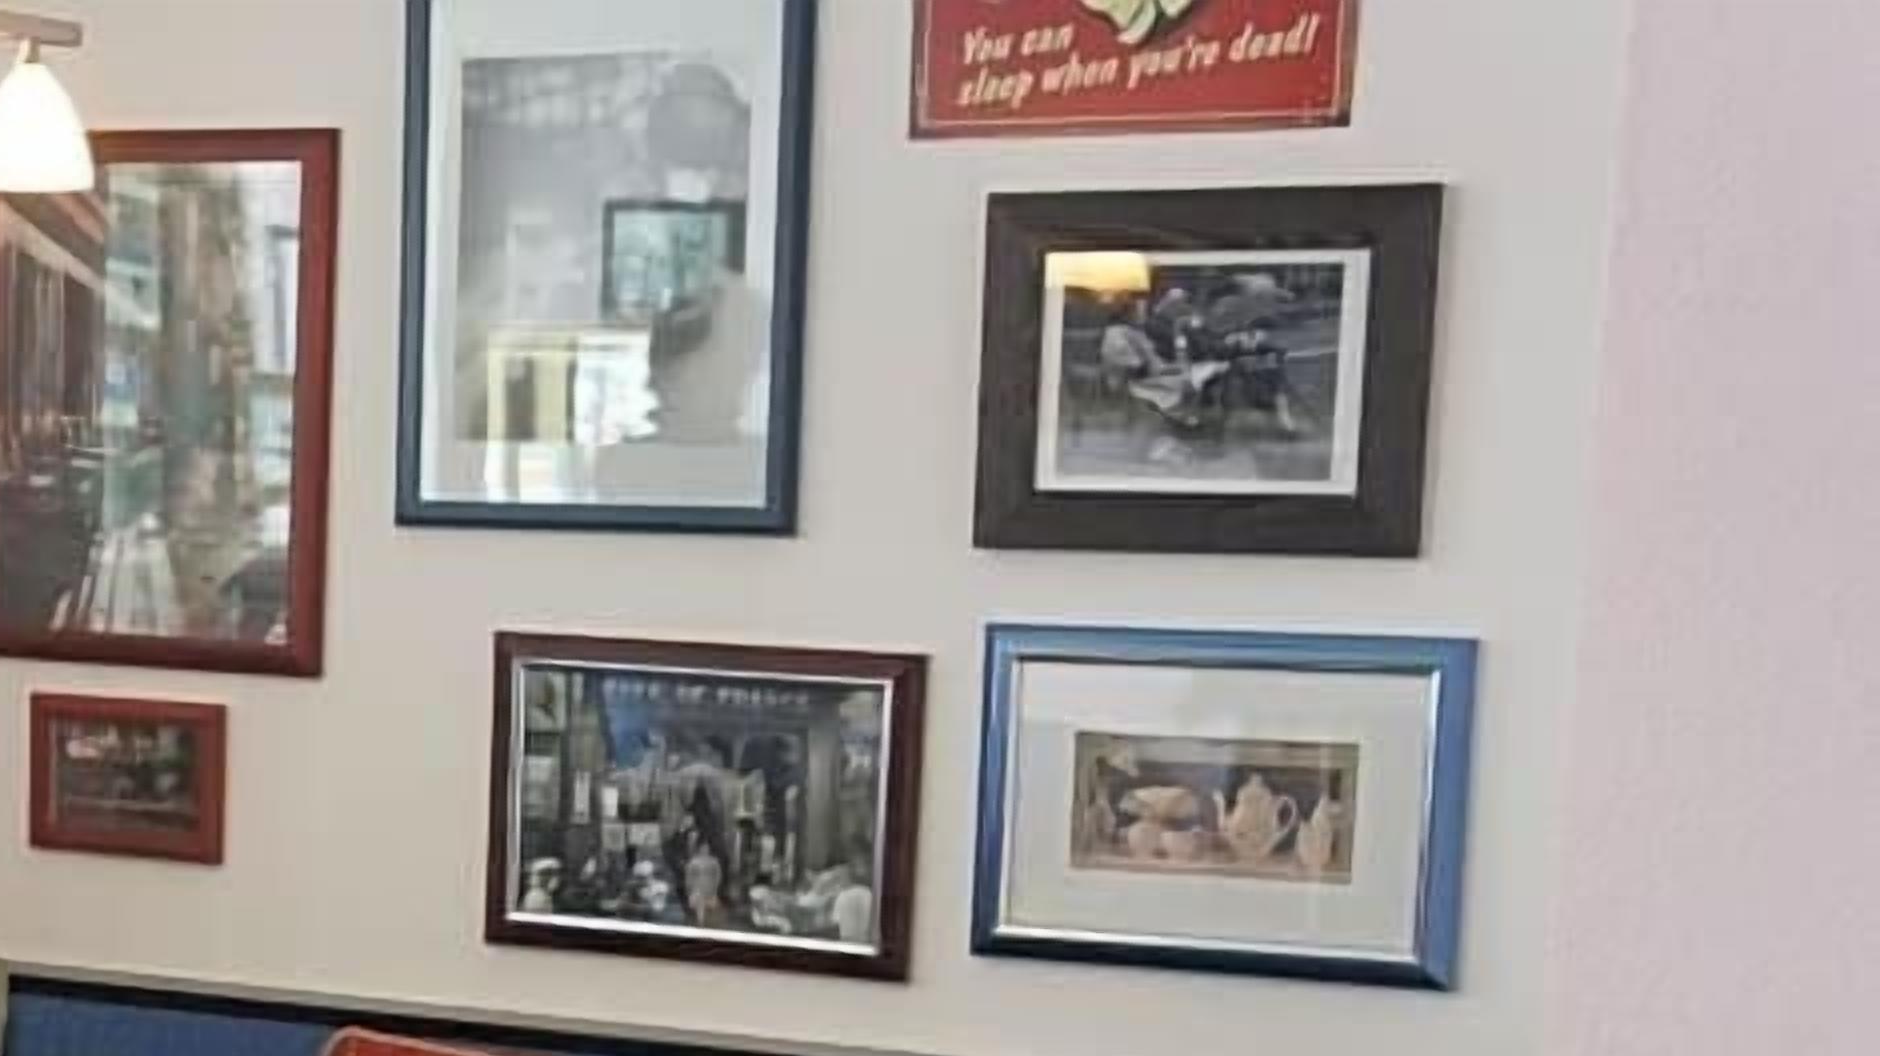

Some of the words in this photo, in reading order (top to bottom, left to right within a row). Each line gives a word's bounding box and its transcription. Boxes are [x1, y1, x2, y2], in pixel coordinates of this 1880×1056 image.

[957, 70, 1034, 109] sleep
[1041, 53, 1119, 95] when
[1127, 36, 1221, 88] you're
[1228, 13, 1319, 61] dead!
[963, 25, 1012, 65] You
[1020, 23, 1074, 57] can
